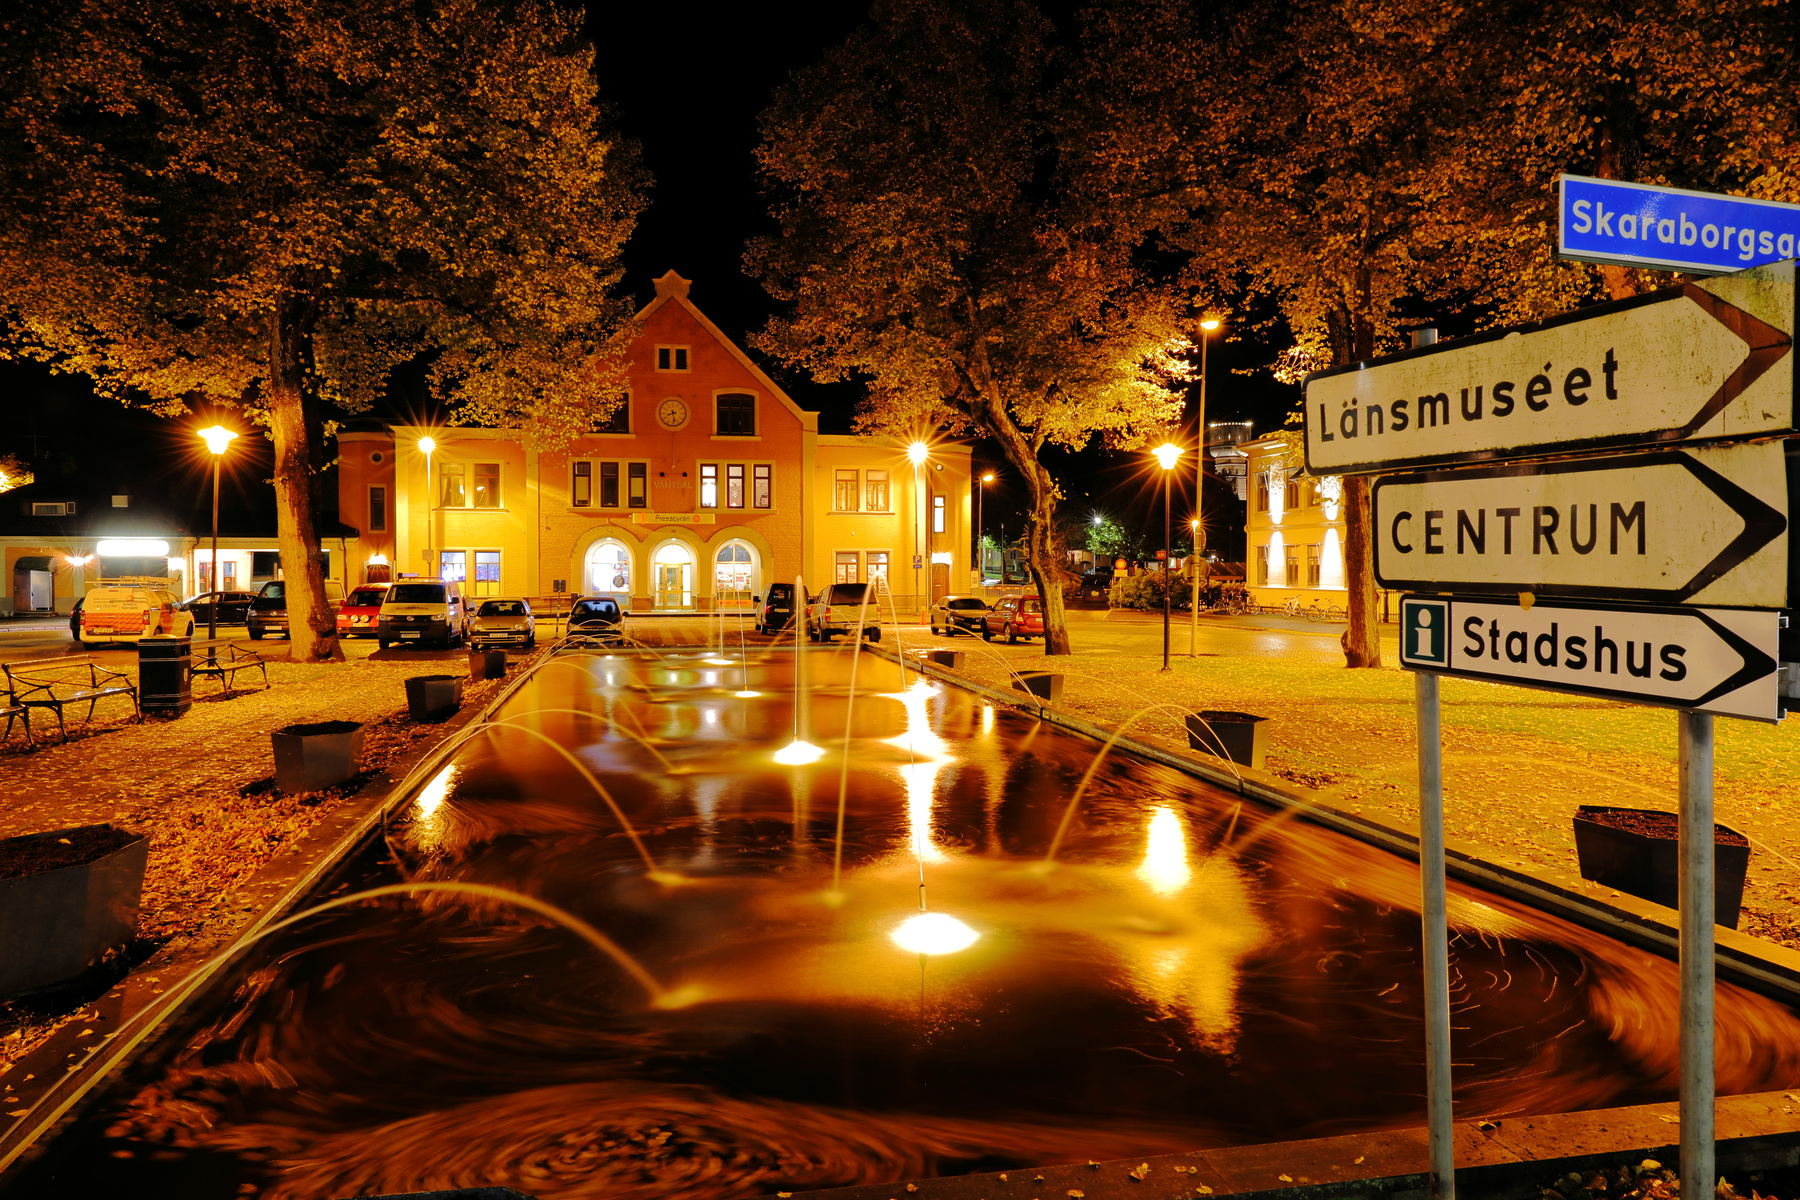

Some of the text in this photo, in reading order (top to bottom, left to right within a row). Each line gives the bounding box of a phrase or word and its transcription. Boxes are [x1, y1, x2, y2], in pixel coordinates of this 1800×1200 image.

[1572, 199, 1800, 261] Skaraborgsg
[1319, 346, 1619, 443] Länsmuséet
[654, 514, 691, 523] Pressbyrån
[1391, 500, 1646, 556] CENTRUM
[1462, 615, 1688, 682] Stadshus
